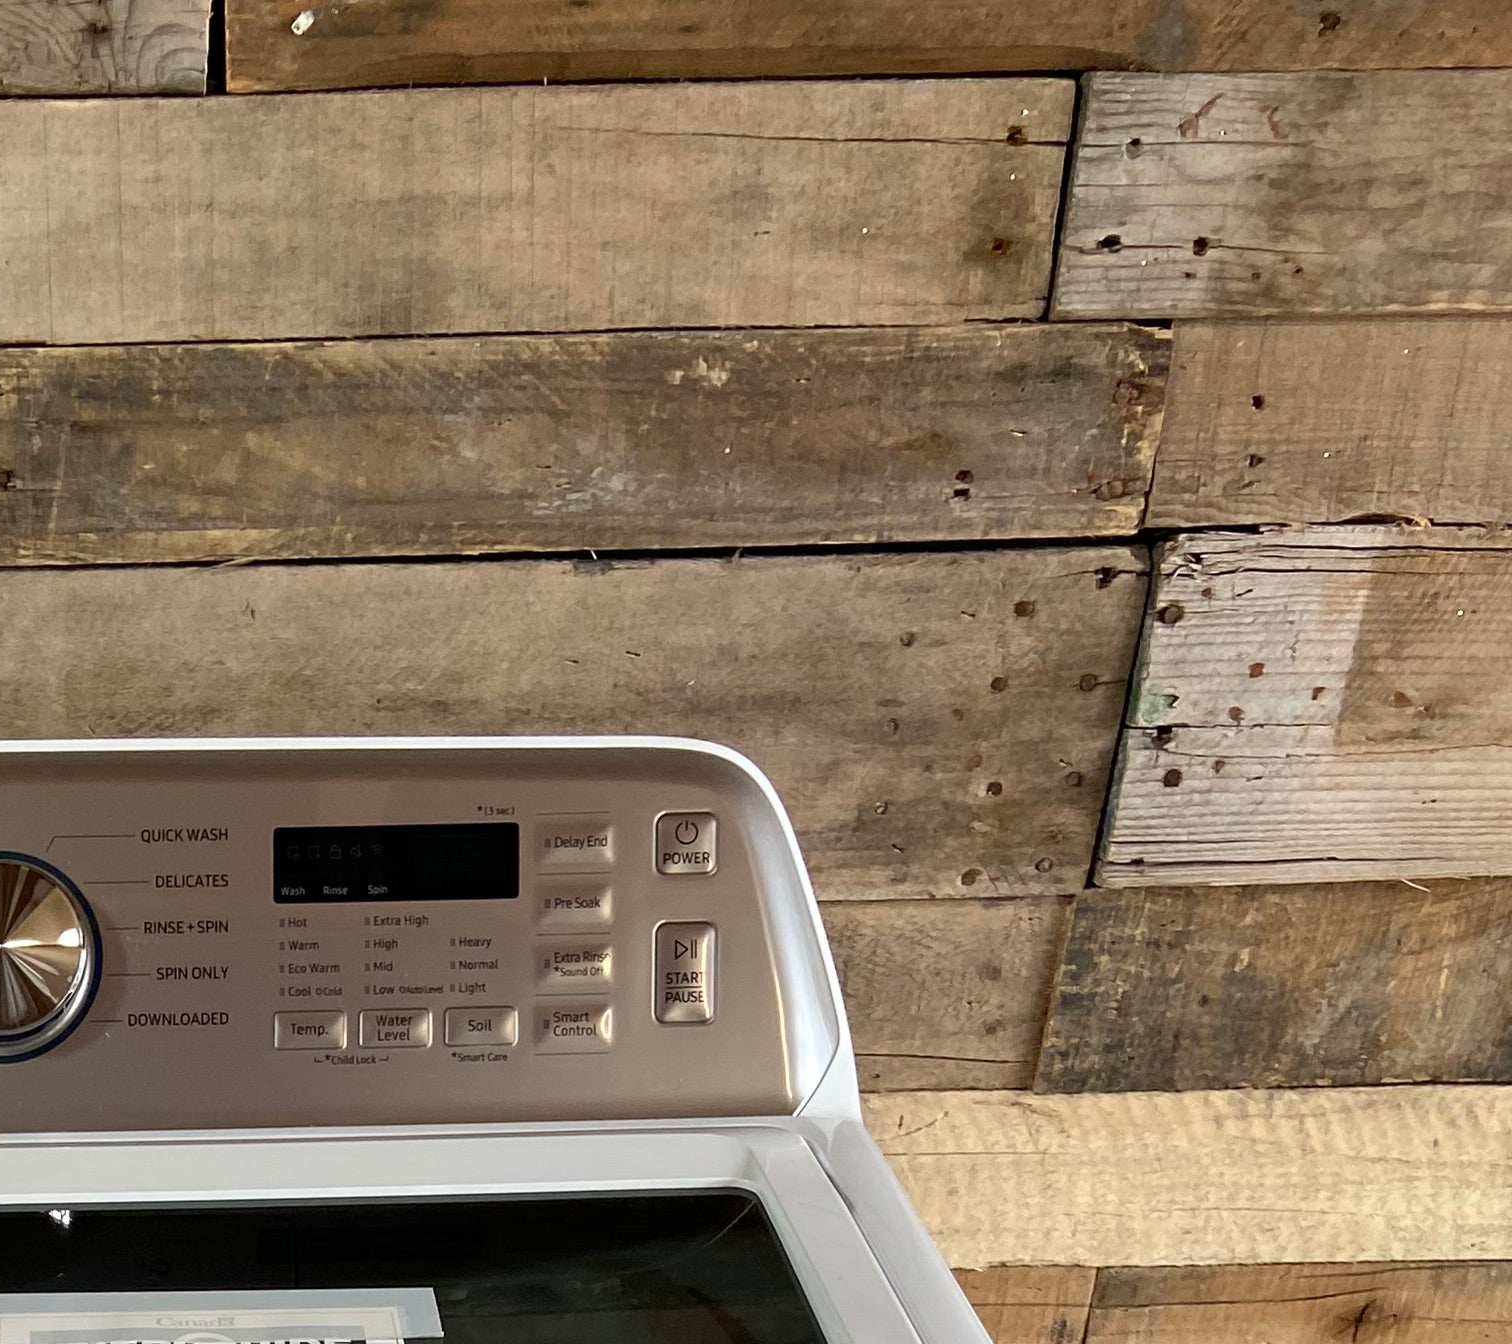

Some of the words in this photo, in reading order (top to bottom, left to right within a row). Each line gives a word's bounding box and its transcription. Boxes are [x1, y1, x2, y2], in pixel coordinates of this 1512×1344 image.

[141, 829, 183, 843] QUICK
[186, 828, 229, 841] WASH
[554, 837, 585, 851] Delay
[587, 836, 608, 847] End
[663, 852, 711, 865] POWER
[156, 874, 229, 888] DELICATES
[281, 886, 306, 896] Wash
[323, 886, 348, 896] Rinse
[367, 884, 388, 896] Spin
[554, 897, 572, 909] Pre
[574, 897, 601, 909] Soak
[144, 921, 184, 934] RINSE
[197, 920, 229, 933] SPIN
[288, 918, 307, 928] Hot
[373, 916, 401, 927] Extra
[404, 915, 429, 928] High
[288, 941, 320, 951] Warm
[373, 940, 398, 952] High
[459, 938, 492, 950] Heavy
[554, 952, 581, 963] Extra
[288, 963, 306, 974] Eco
[309, 963, 340, 973] Warm
[373, 961, 393, 972] Mid
[459, 959, 499, 970] Normal
[157, 967, 188, 980] SPIN
[192, 966, 229, 979] ONLY
[666, 972, 704, 985] START
[288, 986, 311, 997] Cool
[373, 985, 395, 995] Low
[459, 982, 486, 995] Light
[665, 991, 706, 1004] PAUSE
[128, 1012, 229, 1027] DOWNLOADED
[376, 1015, 413, 1027] Water
[553, 1011, 590, 1023] Smart
[290, 1023, 329, 1037] Temp.
[468, 1019, 492, 1032] Soil
[553, 1024, 597, 1037] Control
[377, 1029, 411, 1042] Level
[488, 1053, 508, 1062] Care
